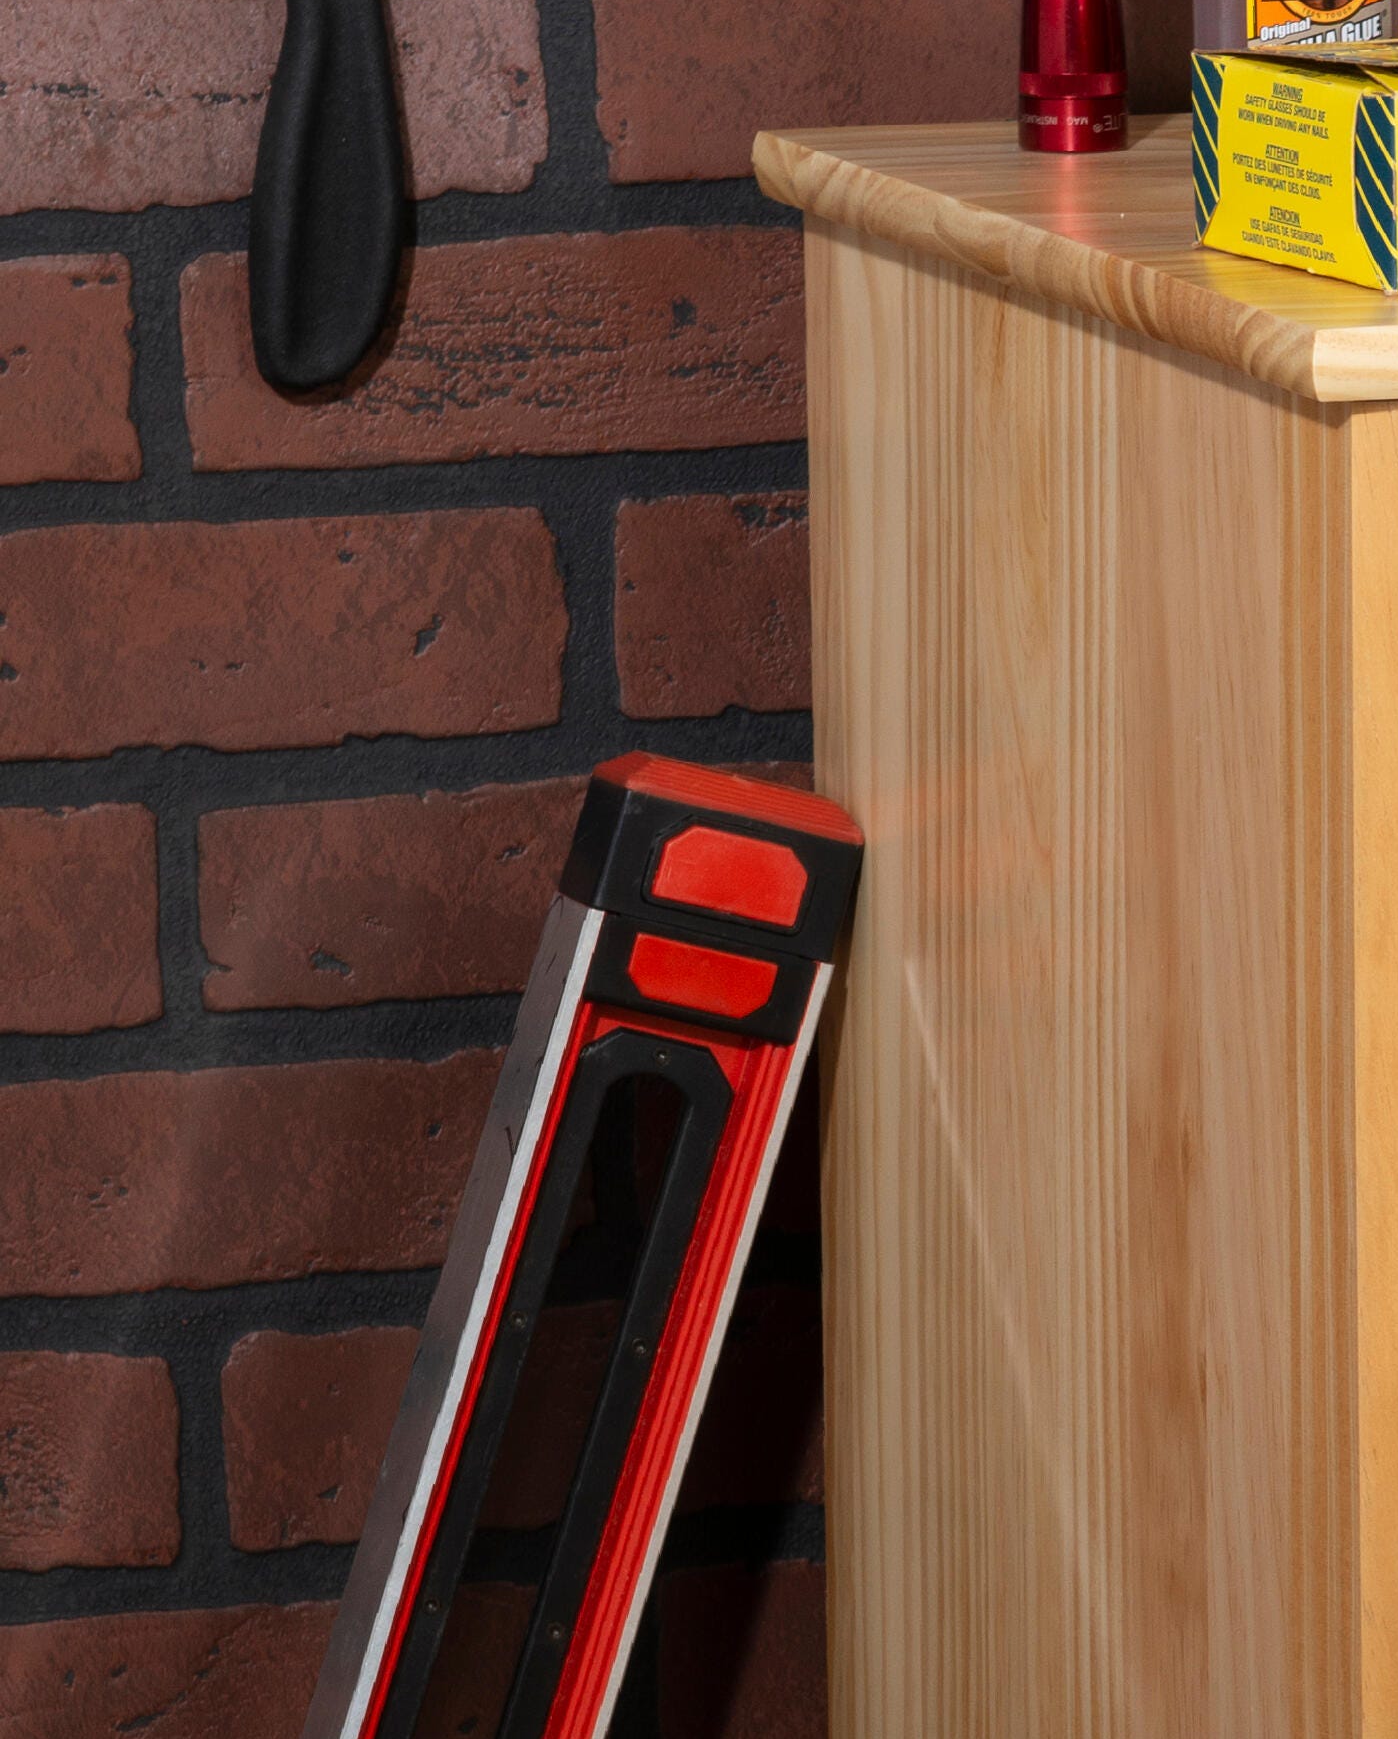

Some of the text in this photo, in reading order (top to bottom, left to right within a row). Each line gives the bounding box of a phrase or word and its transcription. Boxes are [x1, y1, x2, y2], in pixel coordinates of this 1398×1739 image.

[1260, 17, 1312, 41] Original
[1340, 13, 1382, 43] GLUE
[1272, 82, 1303, 101] WARNING
[1245, 94, 1317, 121] SAFETY GLASSES SHOULD
[1066, 116, 1088, 126] MAG
[1238, 108, 1255, 122] WORN
[1256, 112, 1273, 126] WHEN
[1274, 116, 1297, 132] DRIVING
[1298, 121, 1310, 135] ANY
[1265, 144, 1299, 164] ATTENTION
[1267, 160, 1295, 178] LUNETTES
